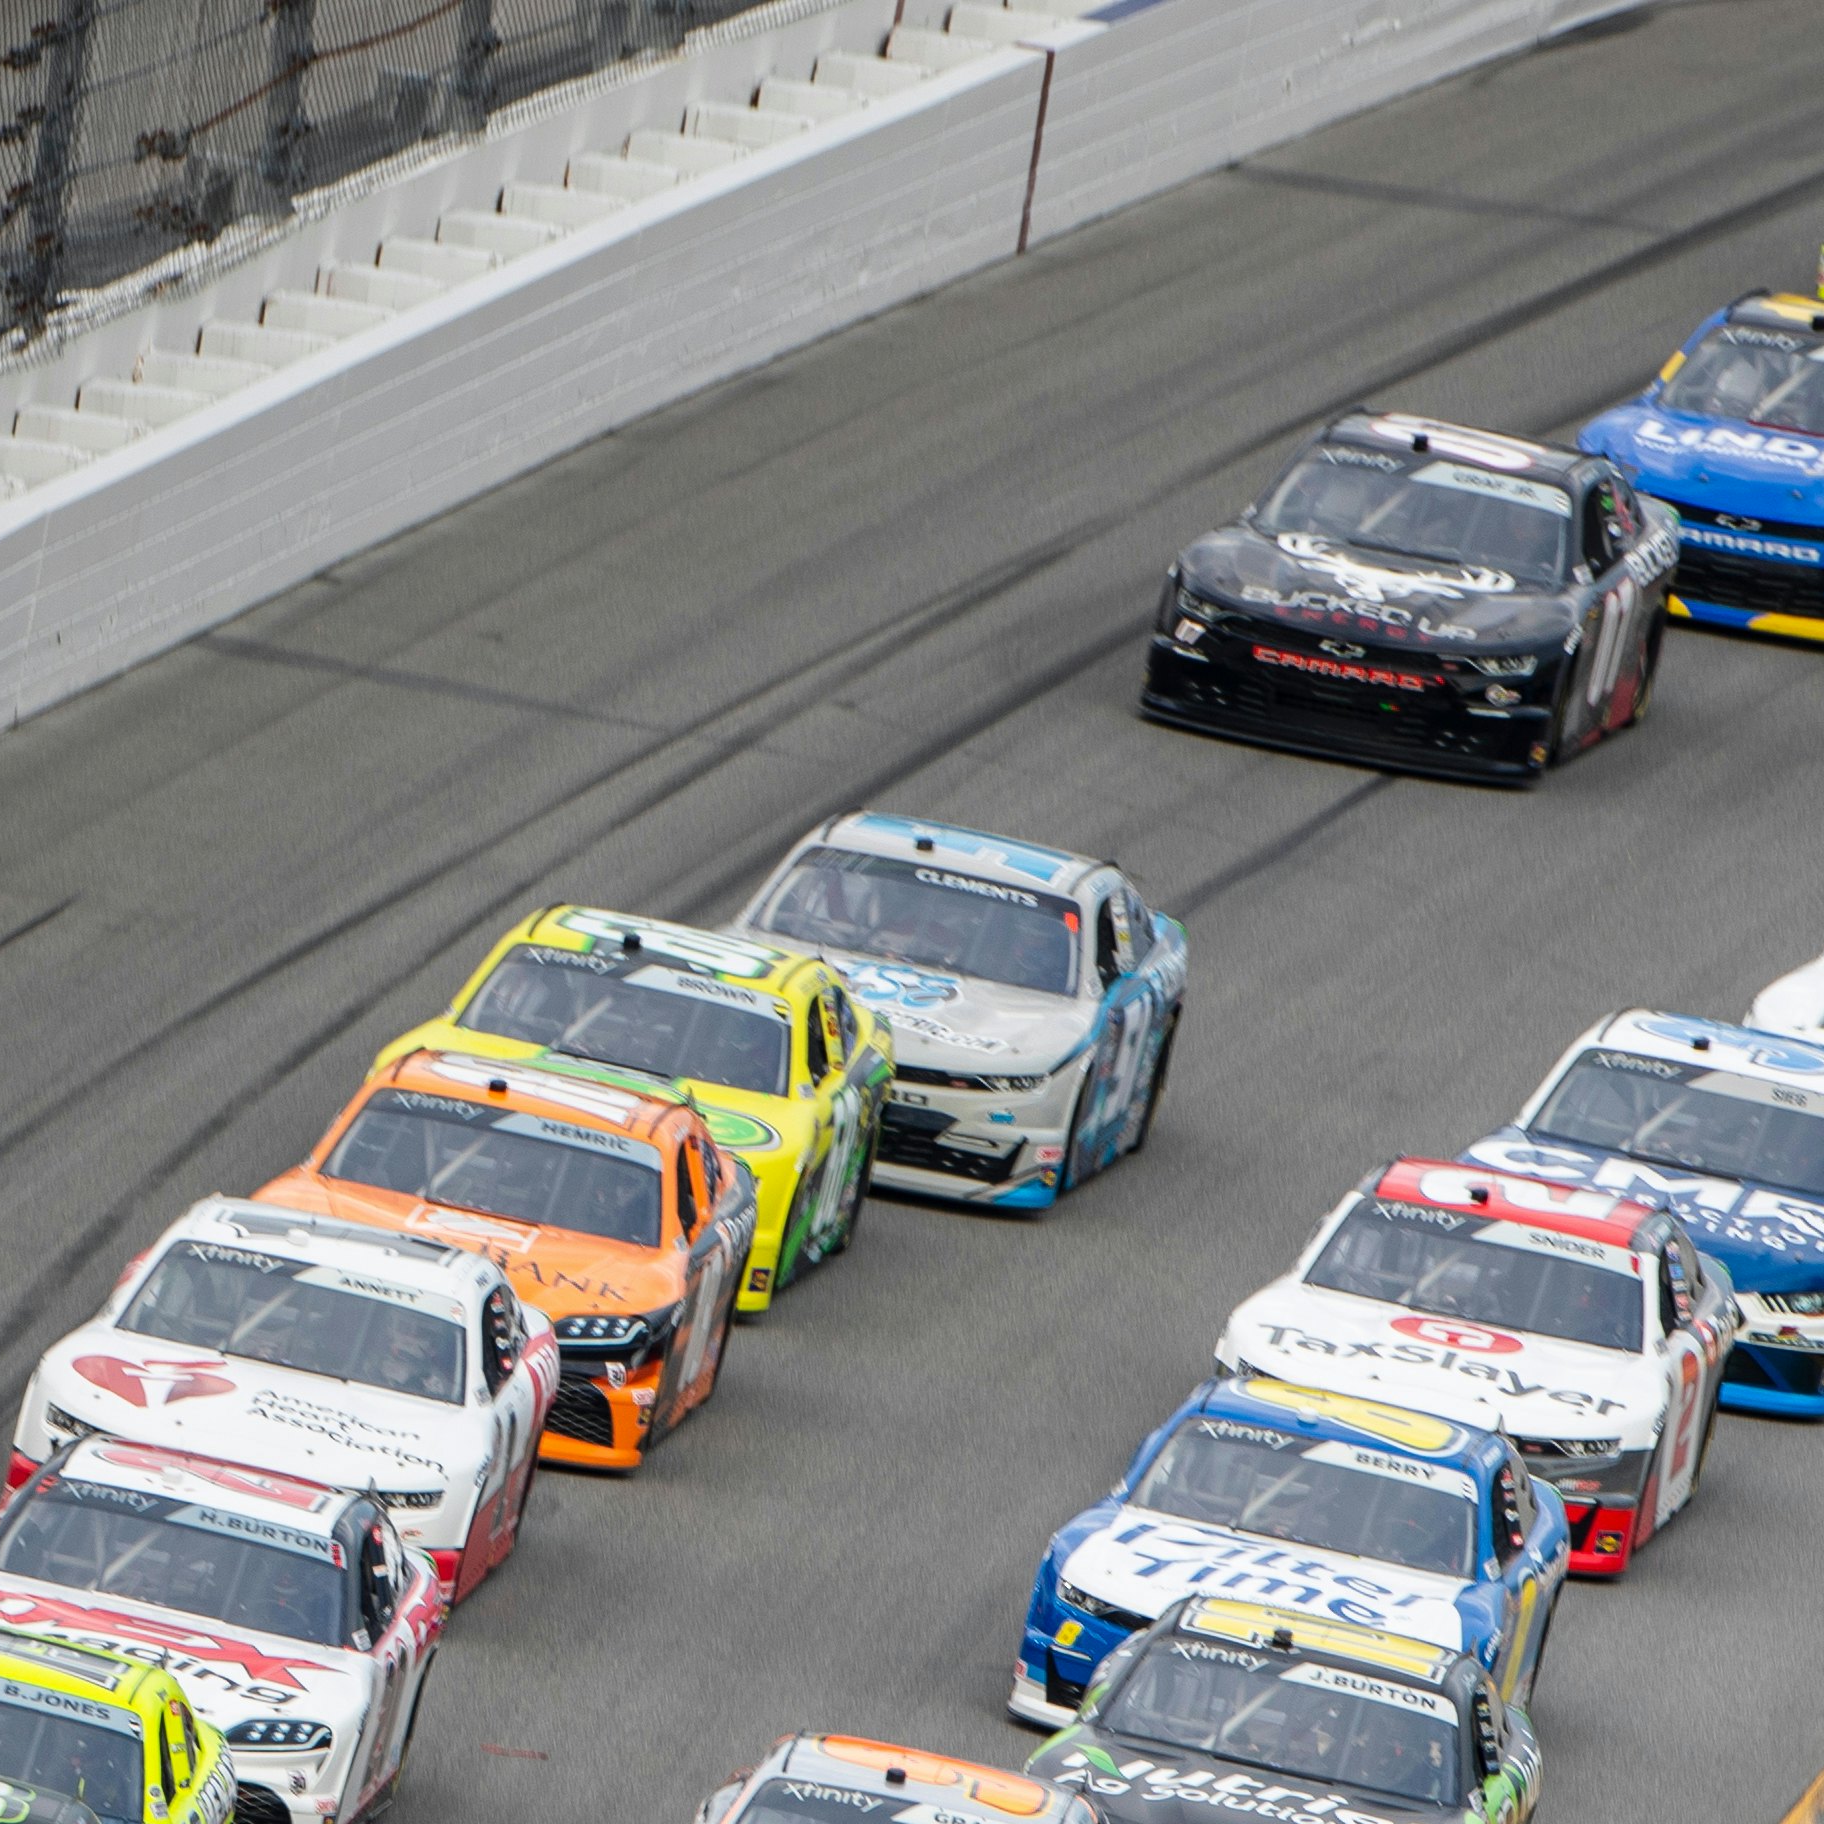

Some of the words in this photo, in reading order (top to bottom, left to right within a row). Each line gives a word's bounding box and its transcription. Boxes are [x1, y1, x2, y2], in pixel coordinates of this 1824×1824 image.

[1678, 527, 1820, 563] AMARO
[1251, 645, 1425, 692] CAMARO
[915, 868, 1040, 908] CLEMENTS
[1528, 1231, 1607, 1261] SNIDER
[338, 1277, 422, 1303] ANNETT
[1258, 1322, 1628, 1418] TaxSlayer
[260, 1388, 422, 1441] American
[246, 1406, 452, 1481] Association
[1353, 1451, 1437, 1482] BERRY
[199, 1508, 332, 1555] H.BURTON
[2, 1681, 111, 1721] B.JONES
[1309, 1670, 1438, 1712] J.BURTON
[783, 1781, 884, 1813] xfinity
